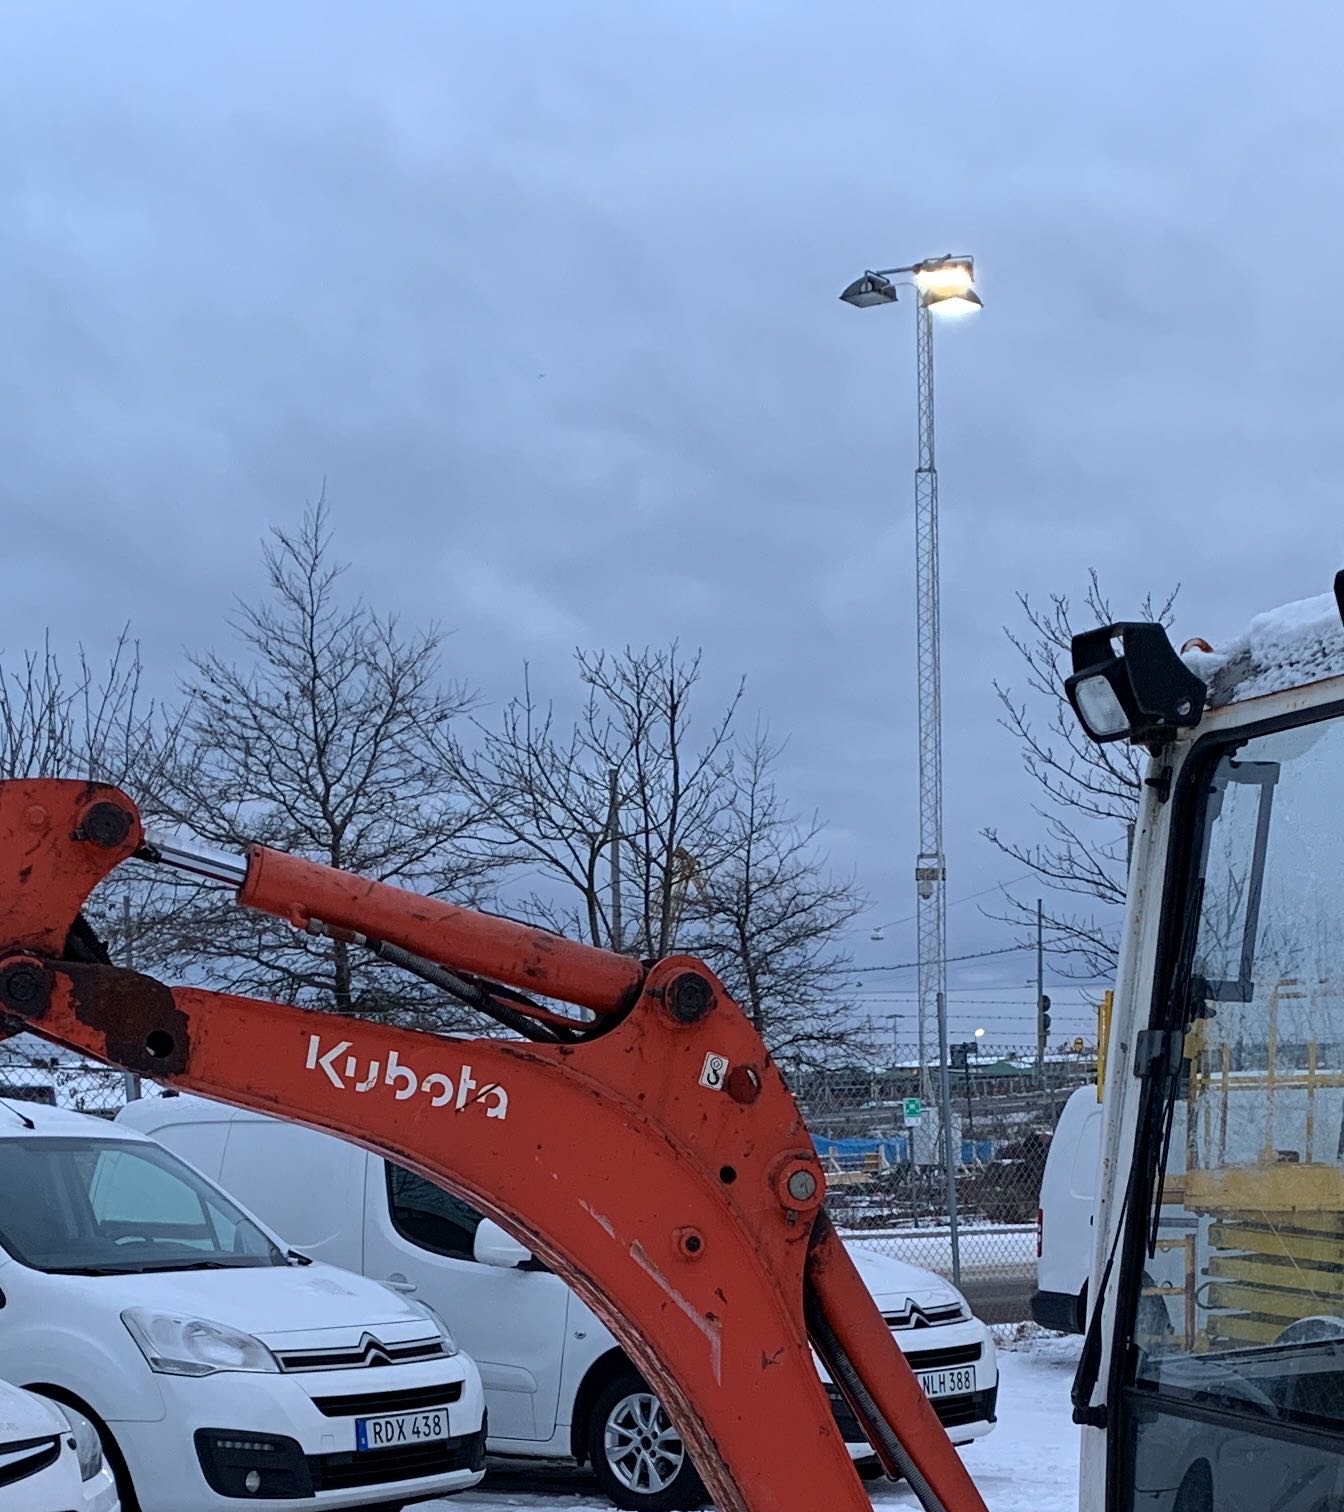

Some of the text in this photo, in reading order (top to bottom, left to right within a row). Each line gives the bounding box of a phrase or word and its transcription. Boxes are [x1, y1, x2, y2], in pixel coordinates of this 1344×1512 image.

[305, 1034, 509, 1120] Kubota
[923, 1371, 971, 1394] NLH 388
[373, 1415, 441, 1444] RDX 438
